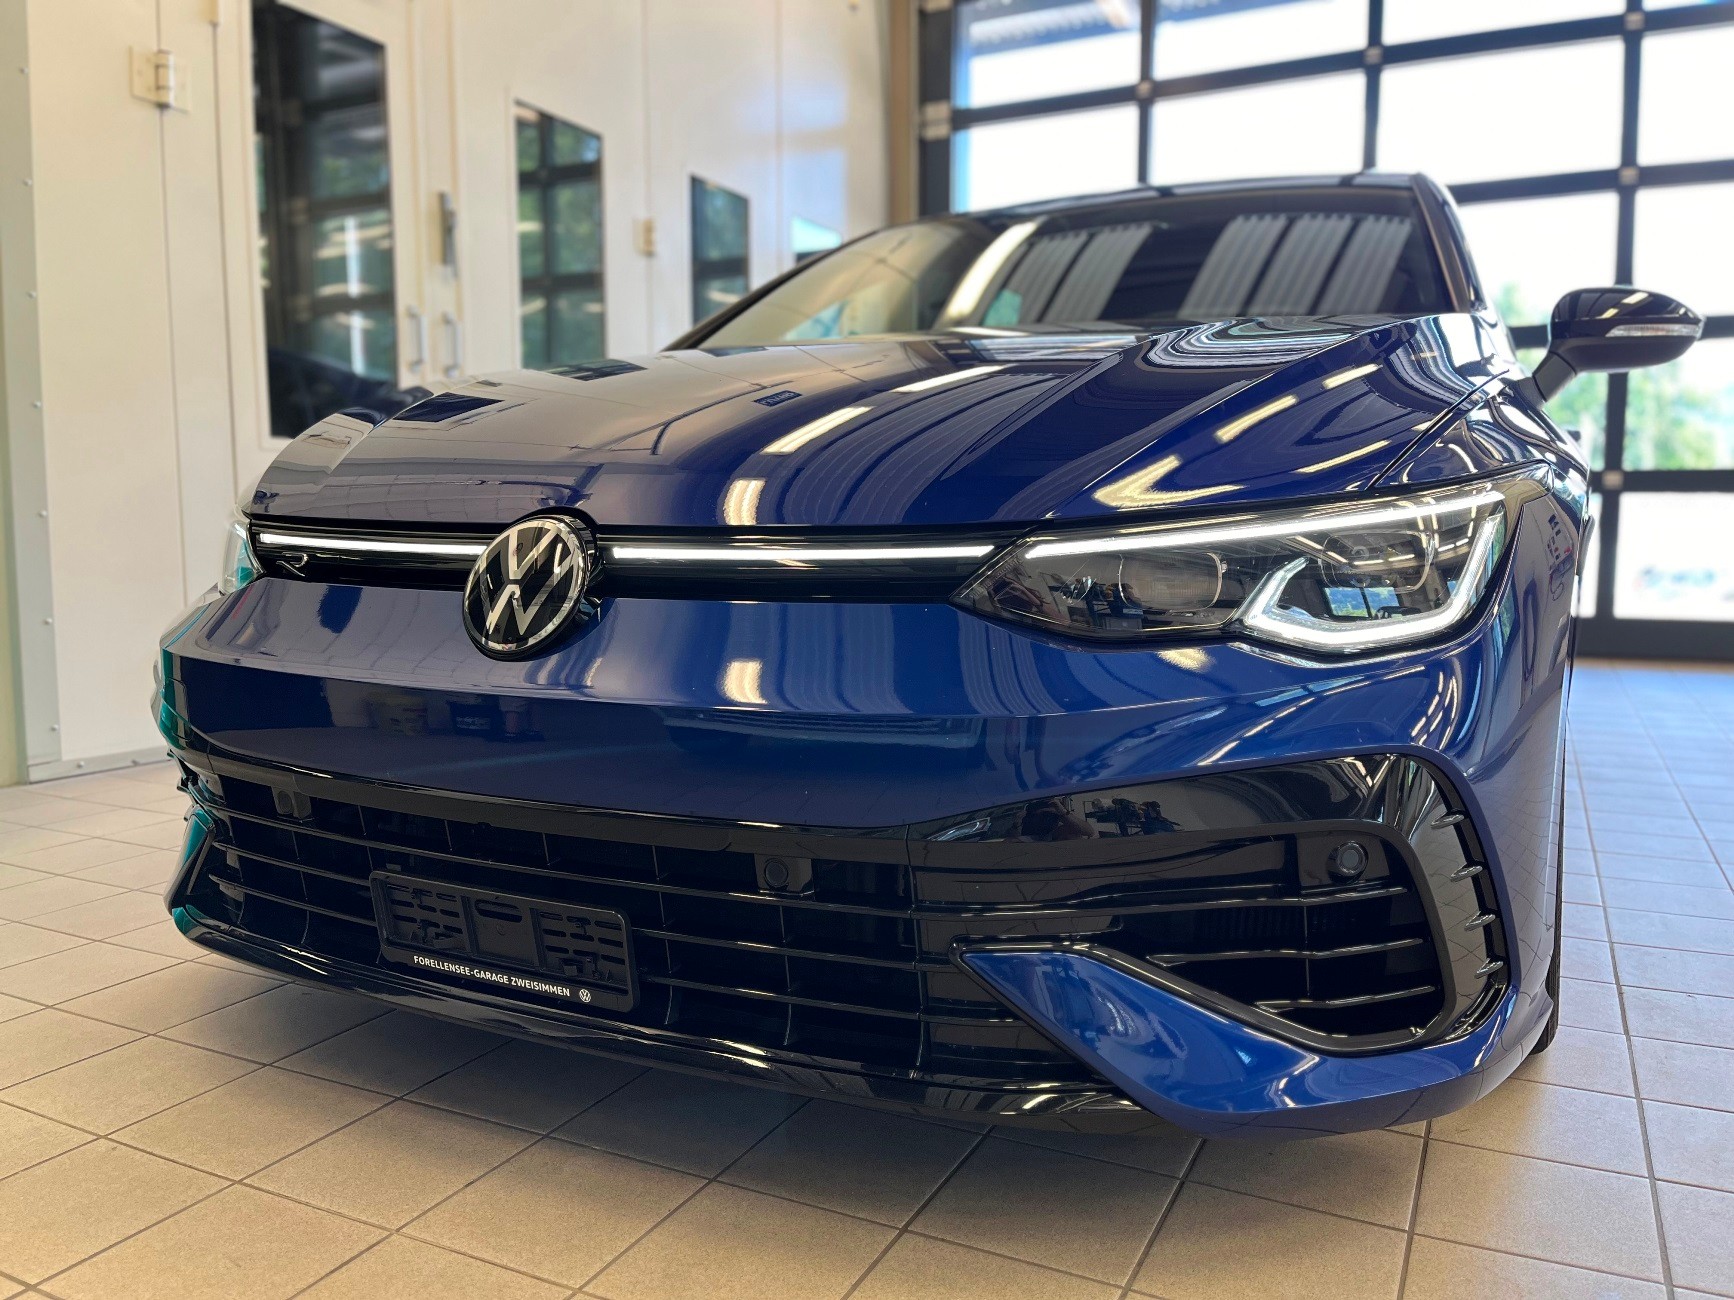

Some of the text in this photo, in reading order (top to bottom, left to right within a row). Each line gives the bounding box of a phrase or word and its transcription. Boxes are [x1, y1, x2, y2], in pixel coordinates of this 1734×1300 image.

[467, 519, 582, 649] VW
[413, 955, 509, 984] FORELLENSEE-GARAGE
[510, 977, 570, 996] ZWEISIMMEN
